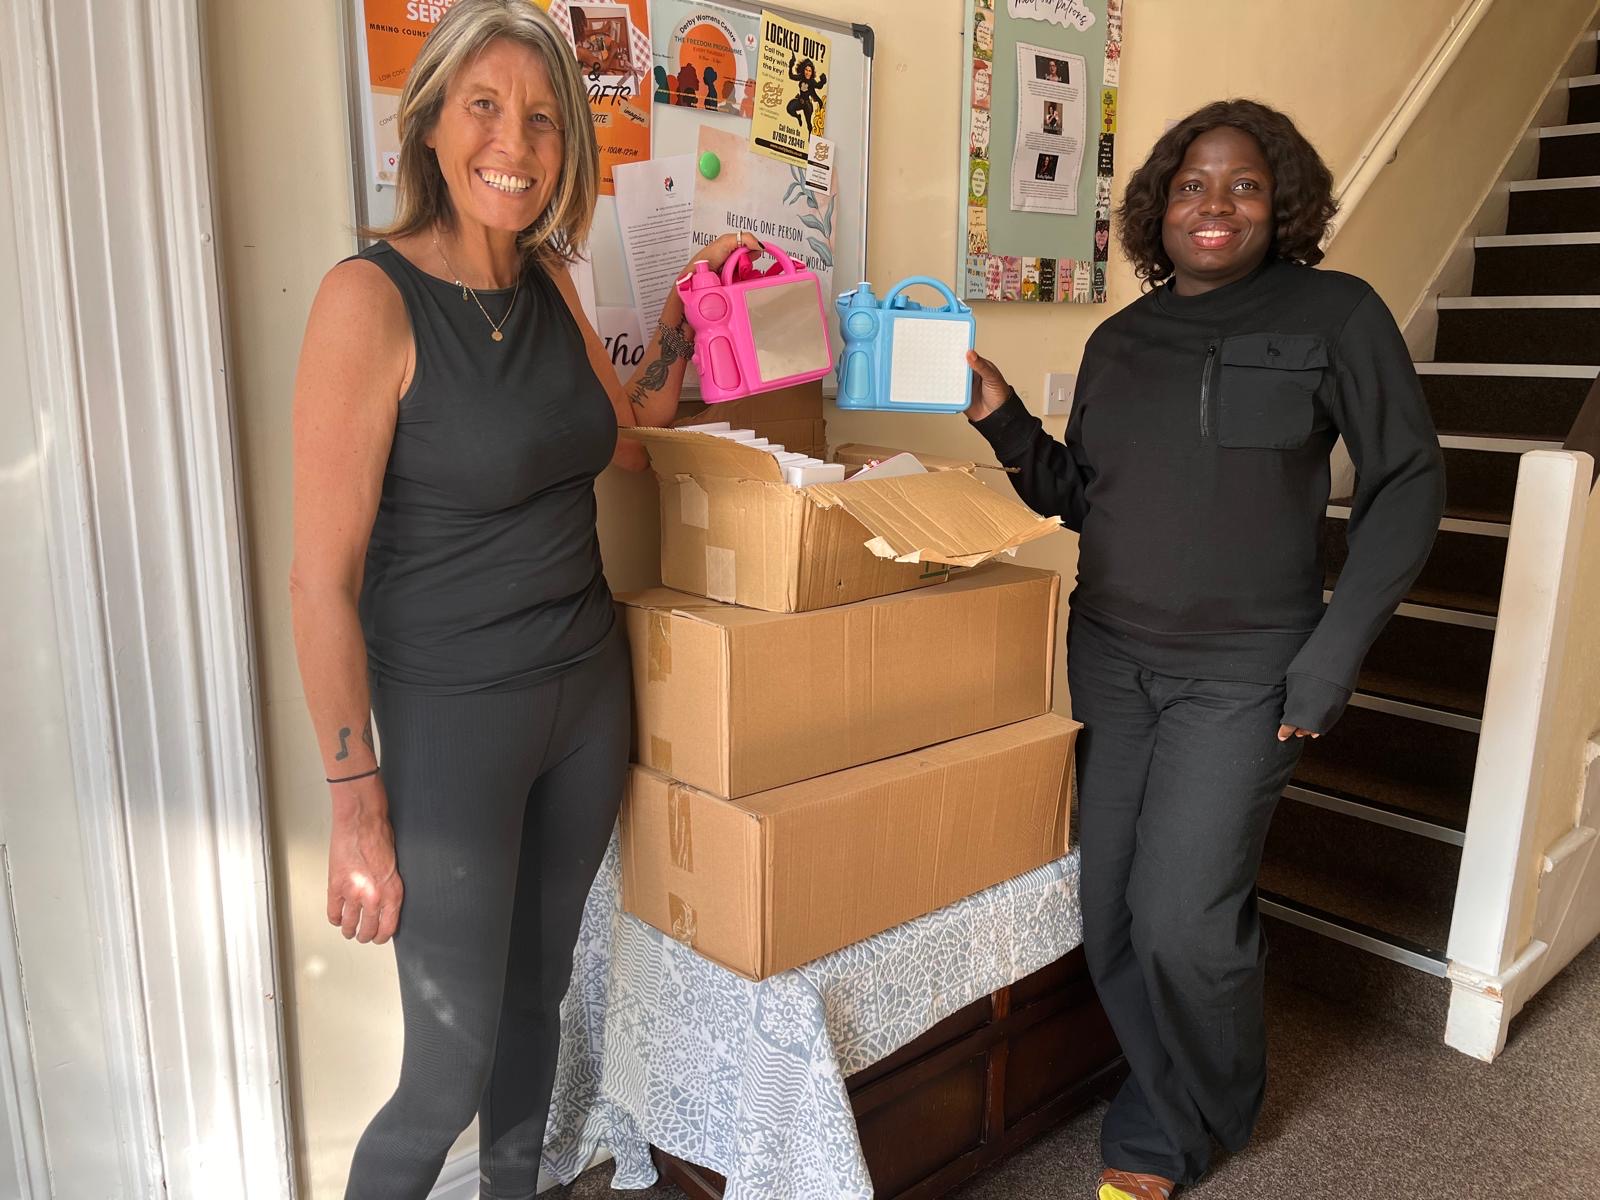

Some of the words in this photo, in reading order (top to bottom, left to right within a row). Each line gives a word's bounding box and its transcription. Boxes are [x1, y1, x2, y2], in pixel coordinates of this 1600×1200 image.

[406, 2, 448, 23] SER
[369, 24, 399, 34] MAKING
[680, 17, 696, 34] Derby
[696, 14, 720, 25] Womens
[720, 22, 736, 42] Centre
[687, 38, 712, 48] FREEDOM
[764, 45, 775, 53] Call
[765, 21, 800, 53] LOCKED
[803, 37, 826, 63] OUT?
[762, 62, 772, 71] the
[763, 53, 776, 65] lady
[776, 59, 788, 68] with
[726, 211, 758, 232] HELPING
[760, 220, 776, 237] ONE
[778, 225, 803, 242] PERSON
